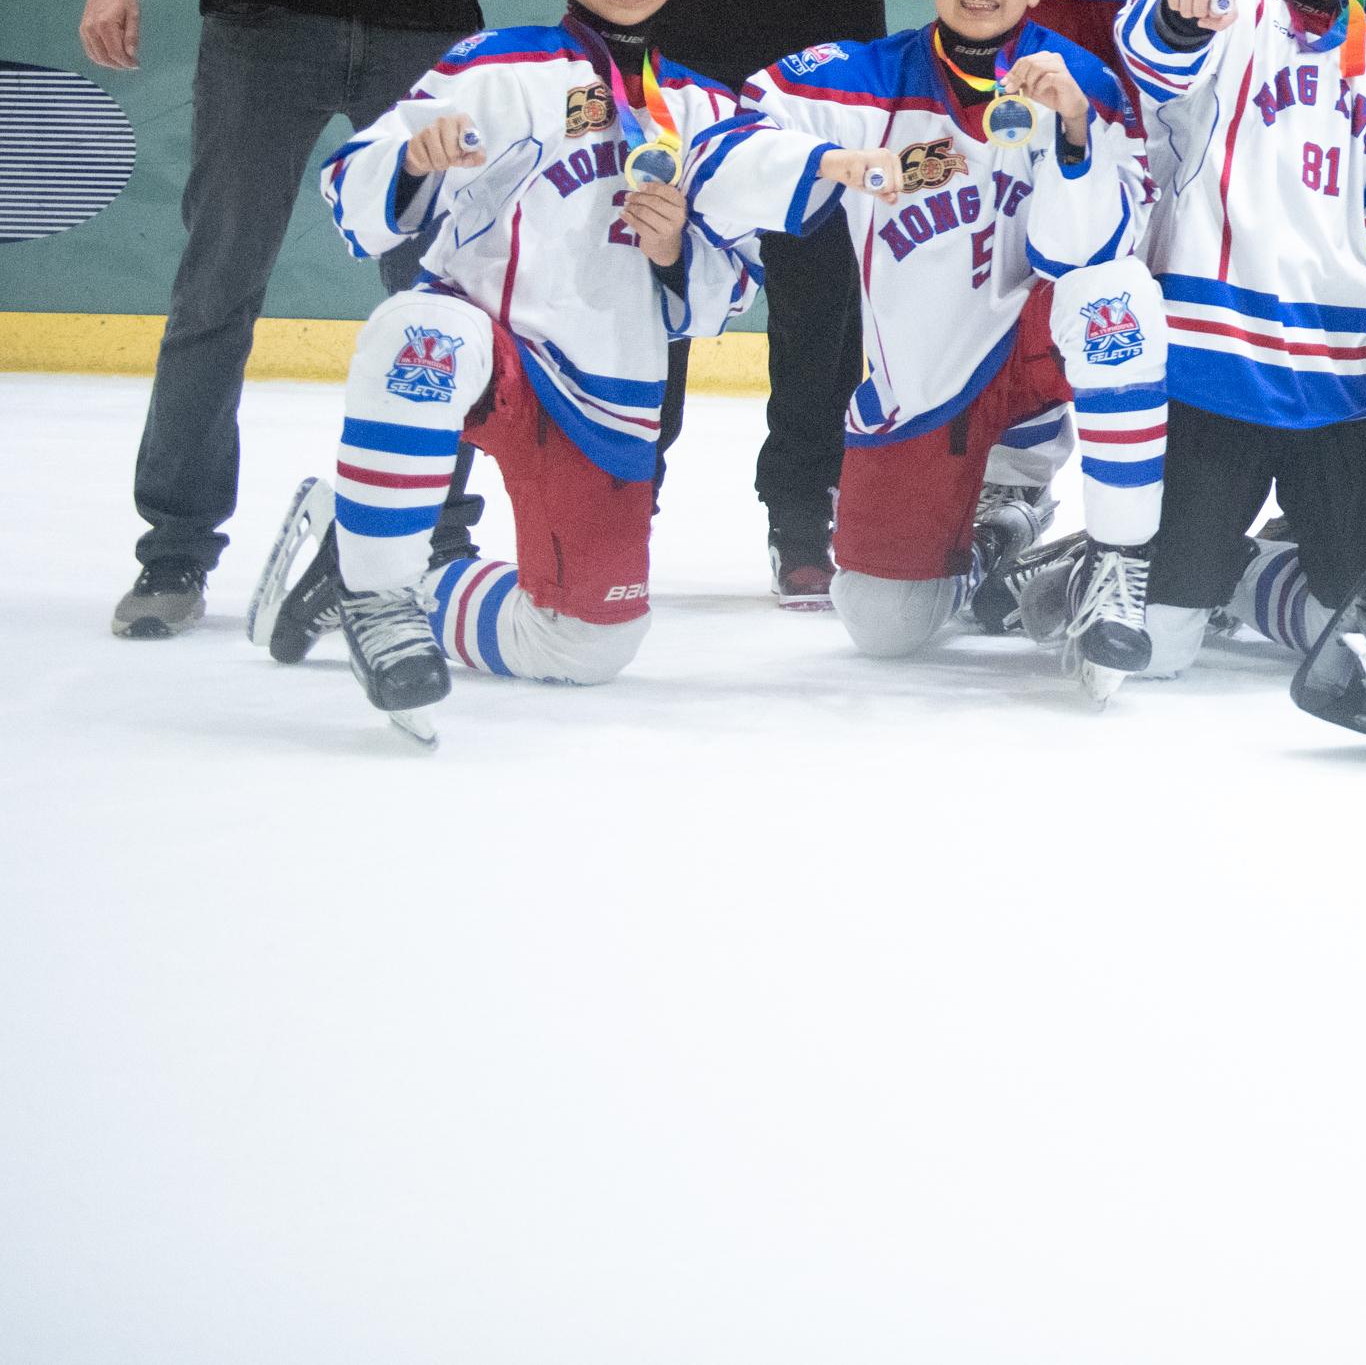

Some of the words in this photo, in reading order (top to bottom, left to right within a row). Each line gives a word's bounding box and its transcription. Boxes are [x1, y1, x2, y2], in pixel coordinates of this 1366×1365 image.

[1301, 141, 1342, 198] 81
[878, 184, 980, 262] HONG
[1088, 346, 1143, 364] SELECTS
[389, 380, 452, 403] SELECTS
